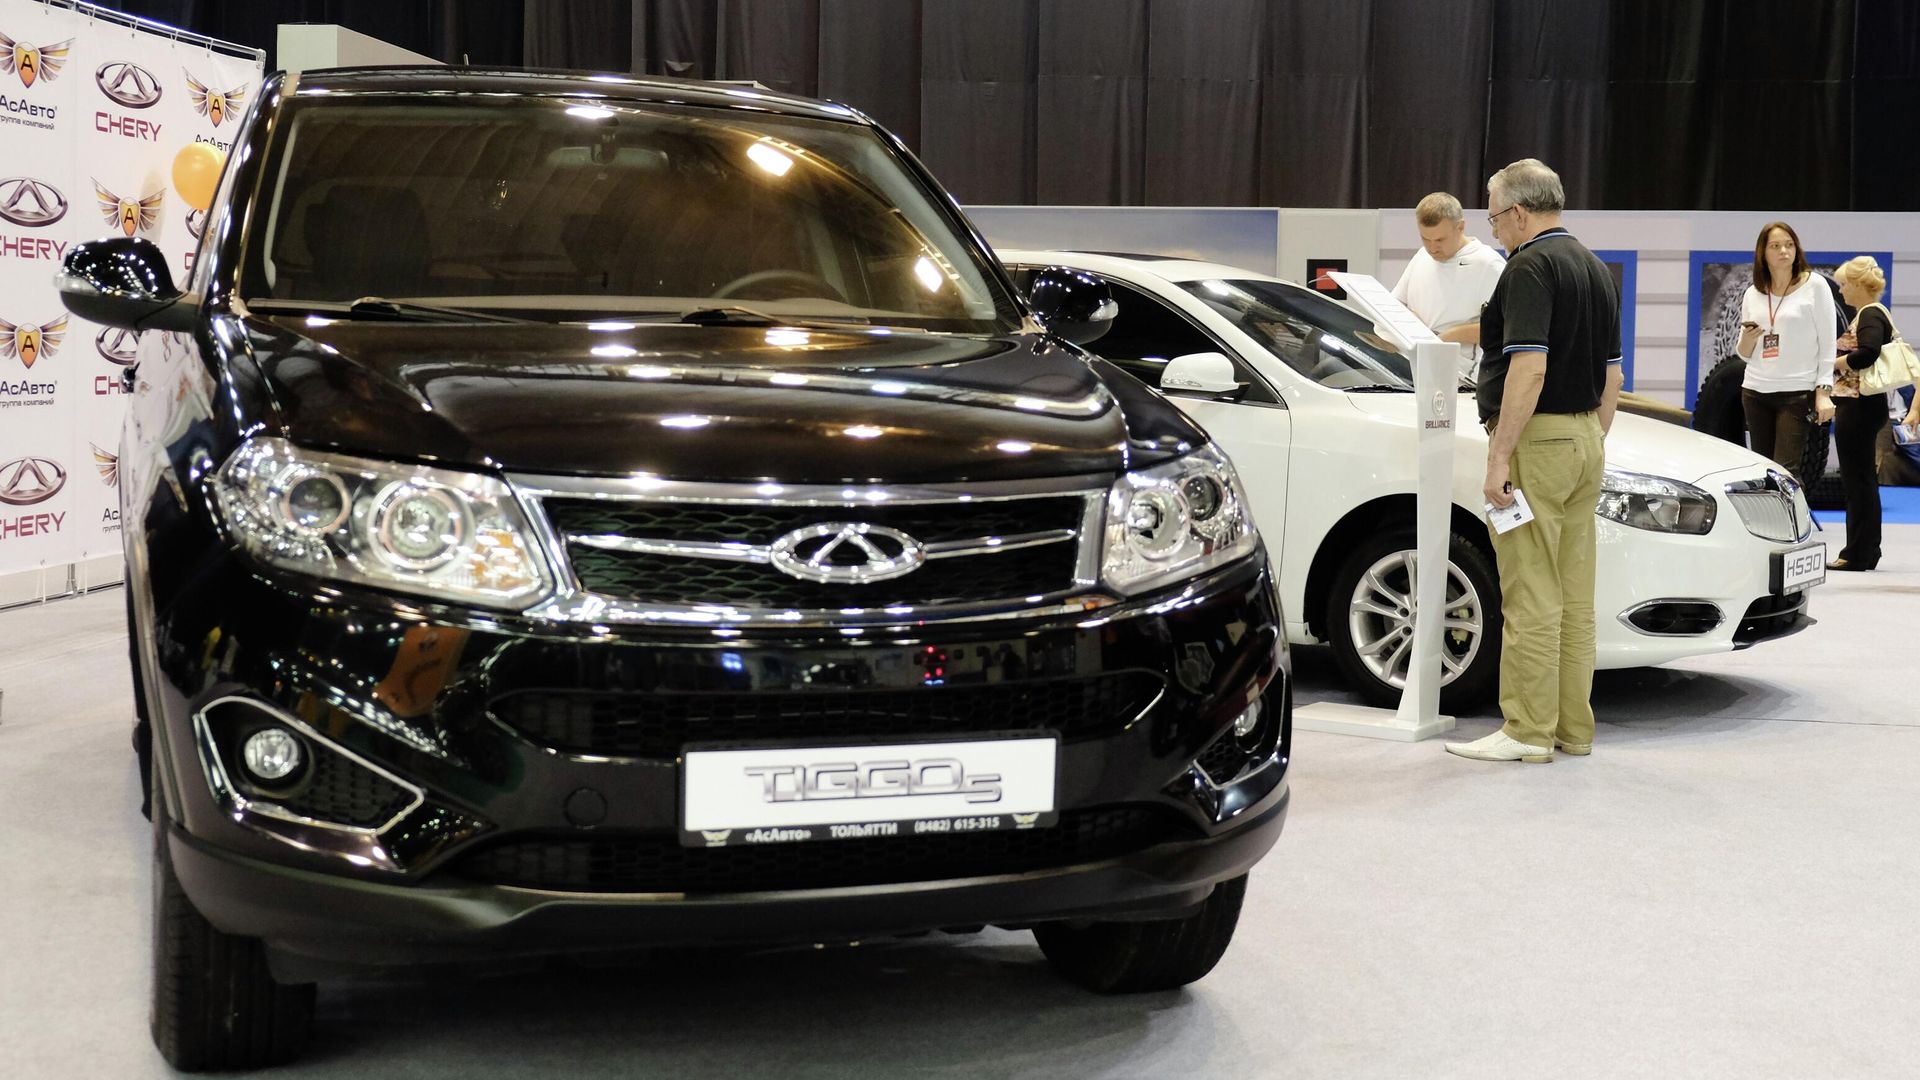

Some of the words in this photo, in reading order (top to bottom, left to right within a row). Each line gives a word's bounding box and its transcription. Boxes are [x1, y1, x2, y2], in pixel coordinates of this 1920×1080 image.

[95, 111, 162, 142] CHERY
[0, 235, 68, 261] HERY
[1425, 419, 1450, 429] BRILLIANCE
[0, 511, 66, 540] HERY
[830, 822, 898, 838] ТОЛЬЯТТИ
[914, 819, 951, 833] (8482)
[953, 816, 1000, 830] 615-315
